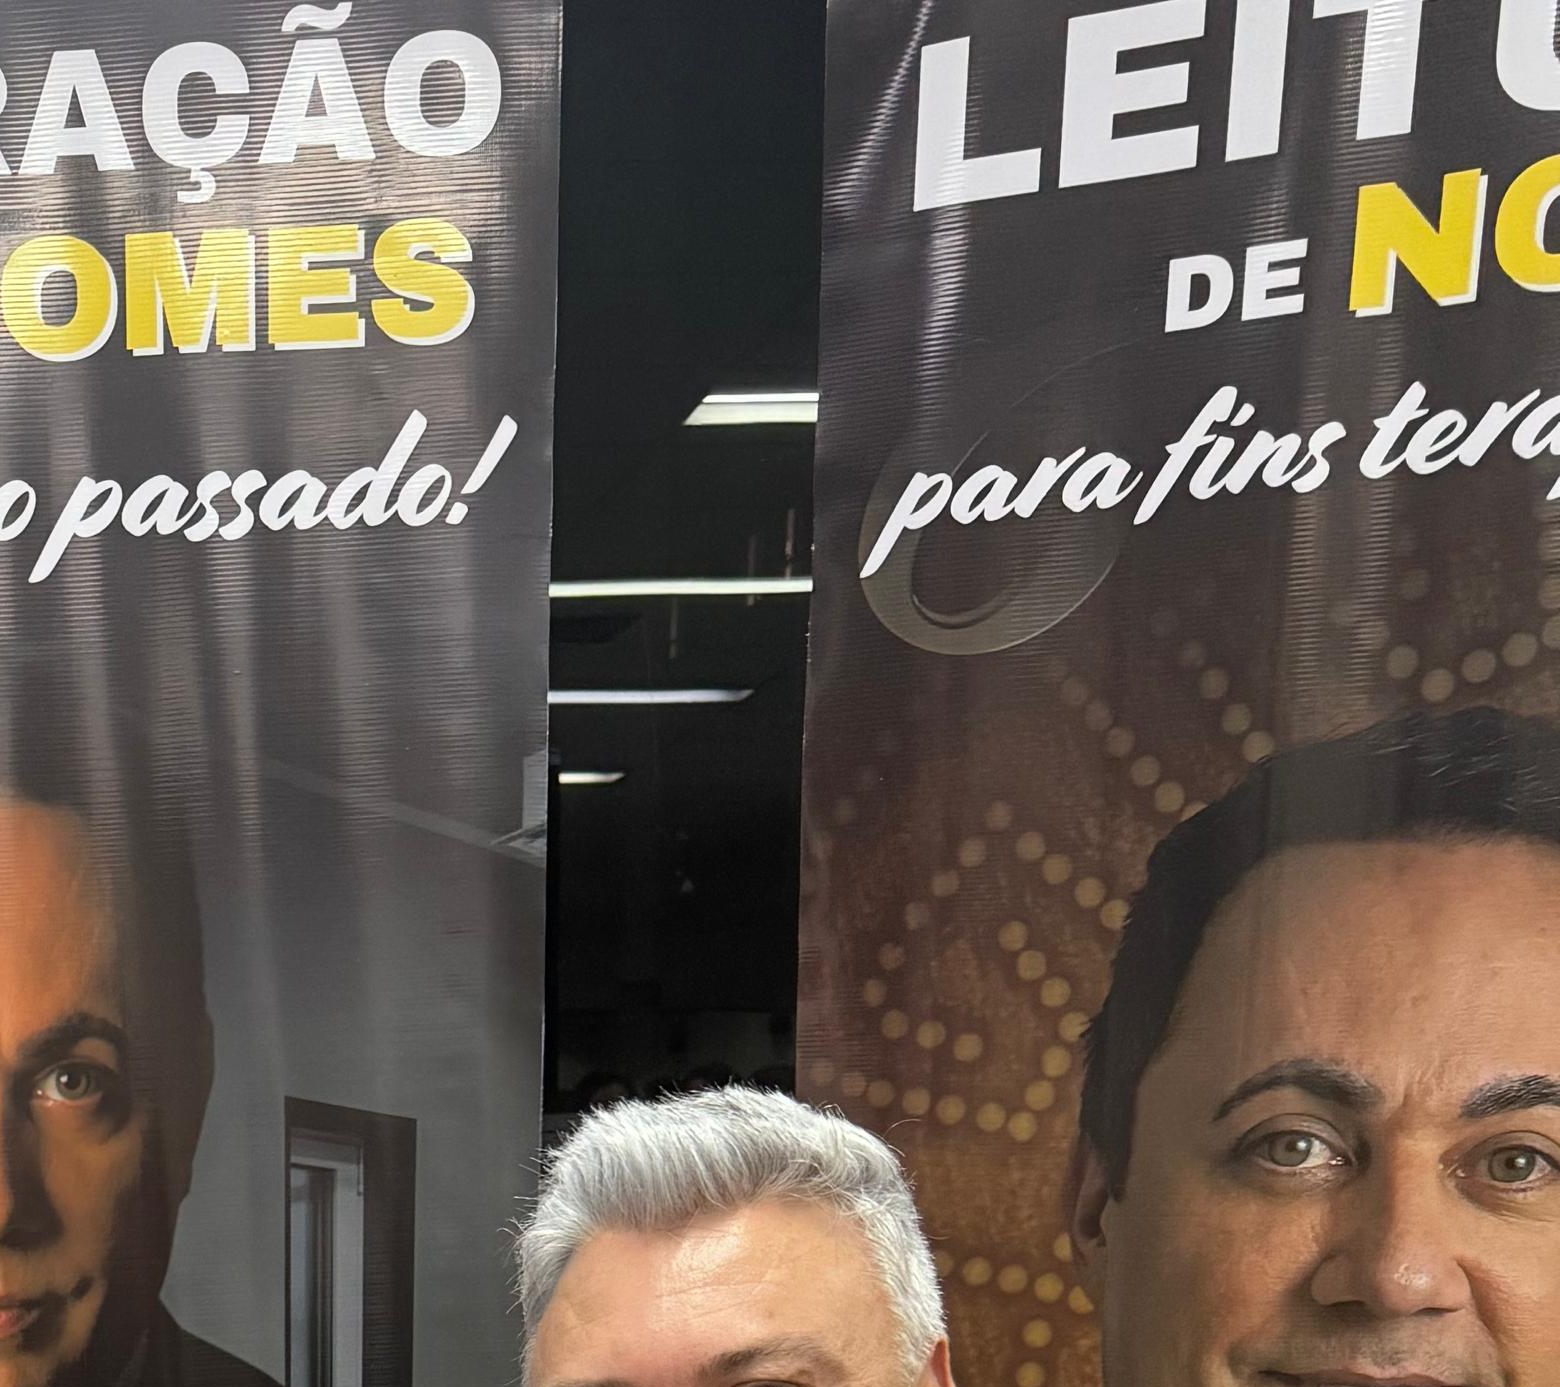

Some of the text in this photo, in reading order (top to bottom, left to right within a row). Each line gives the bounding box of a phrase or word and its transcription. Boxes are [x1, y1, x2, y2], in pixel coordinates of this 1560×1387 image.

[1165, 238, 1308, 333] DE
[28, 409, 518, 584] passado!
[860, 381, 1560, 579] para fins tera
